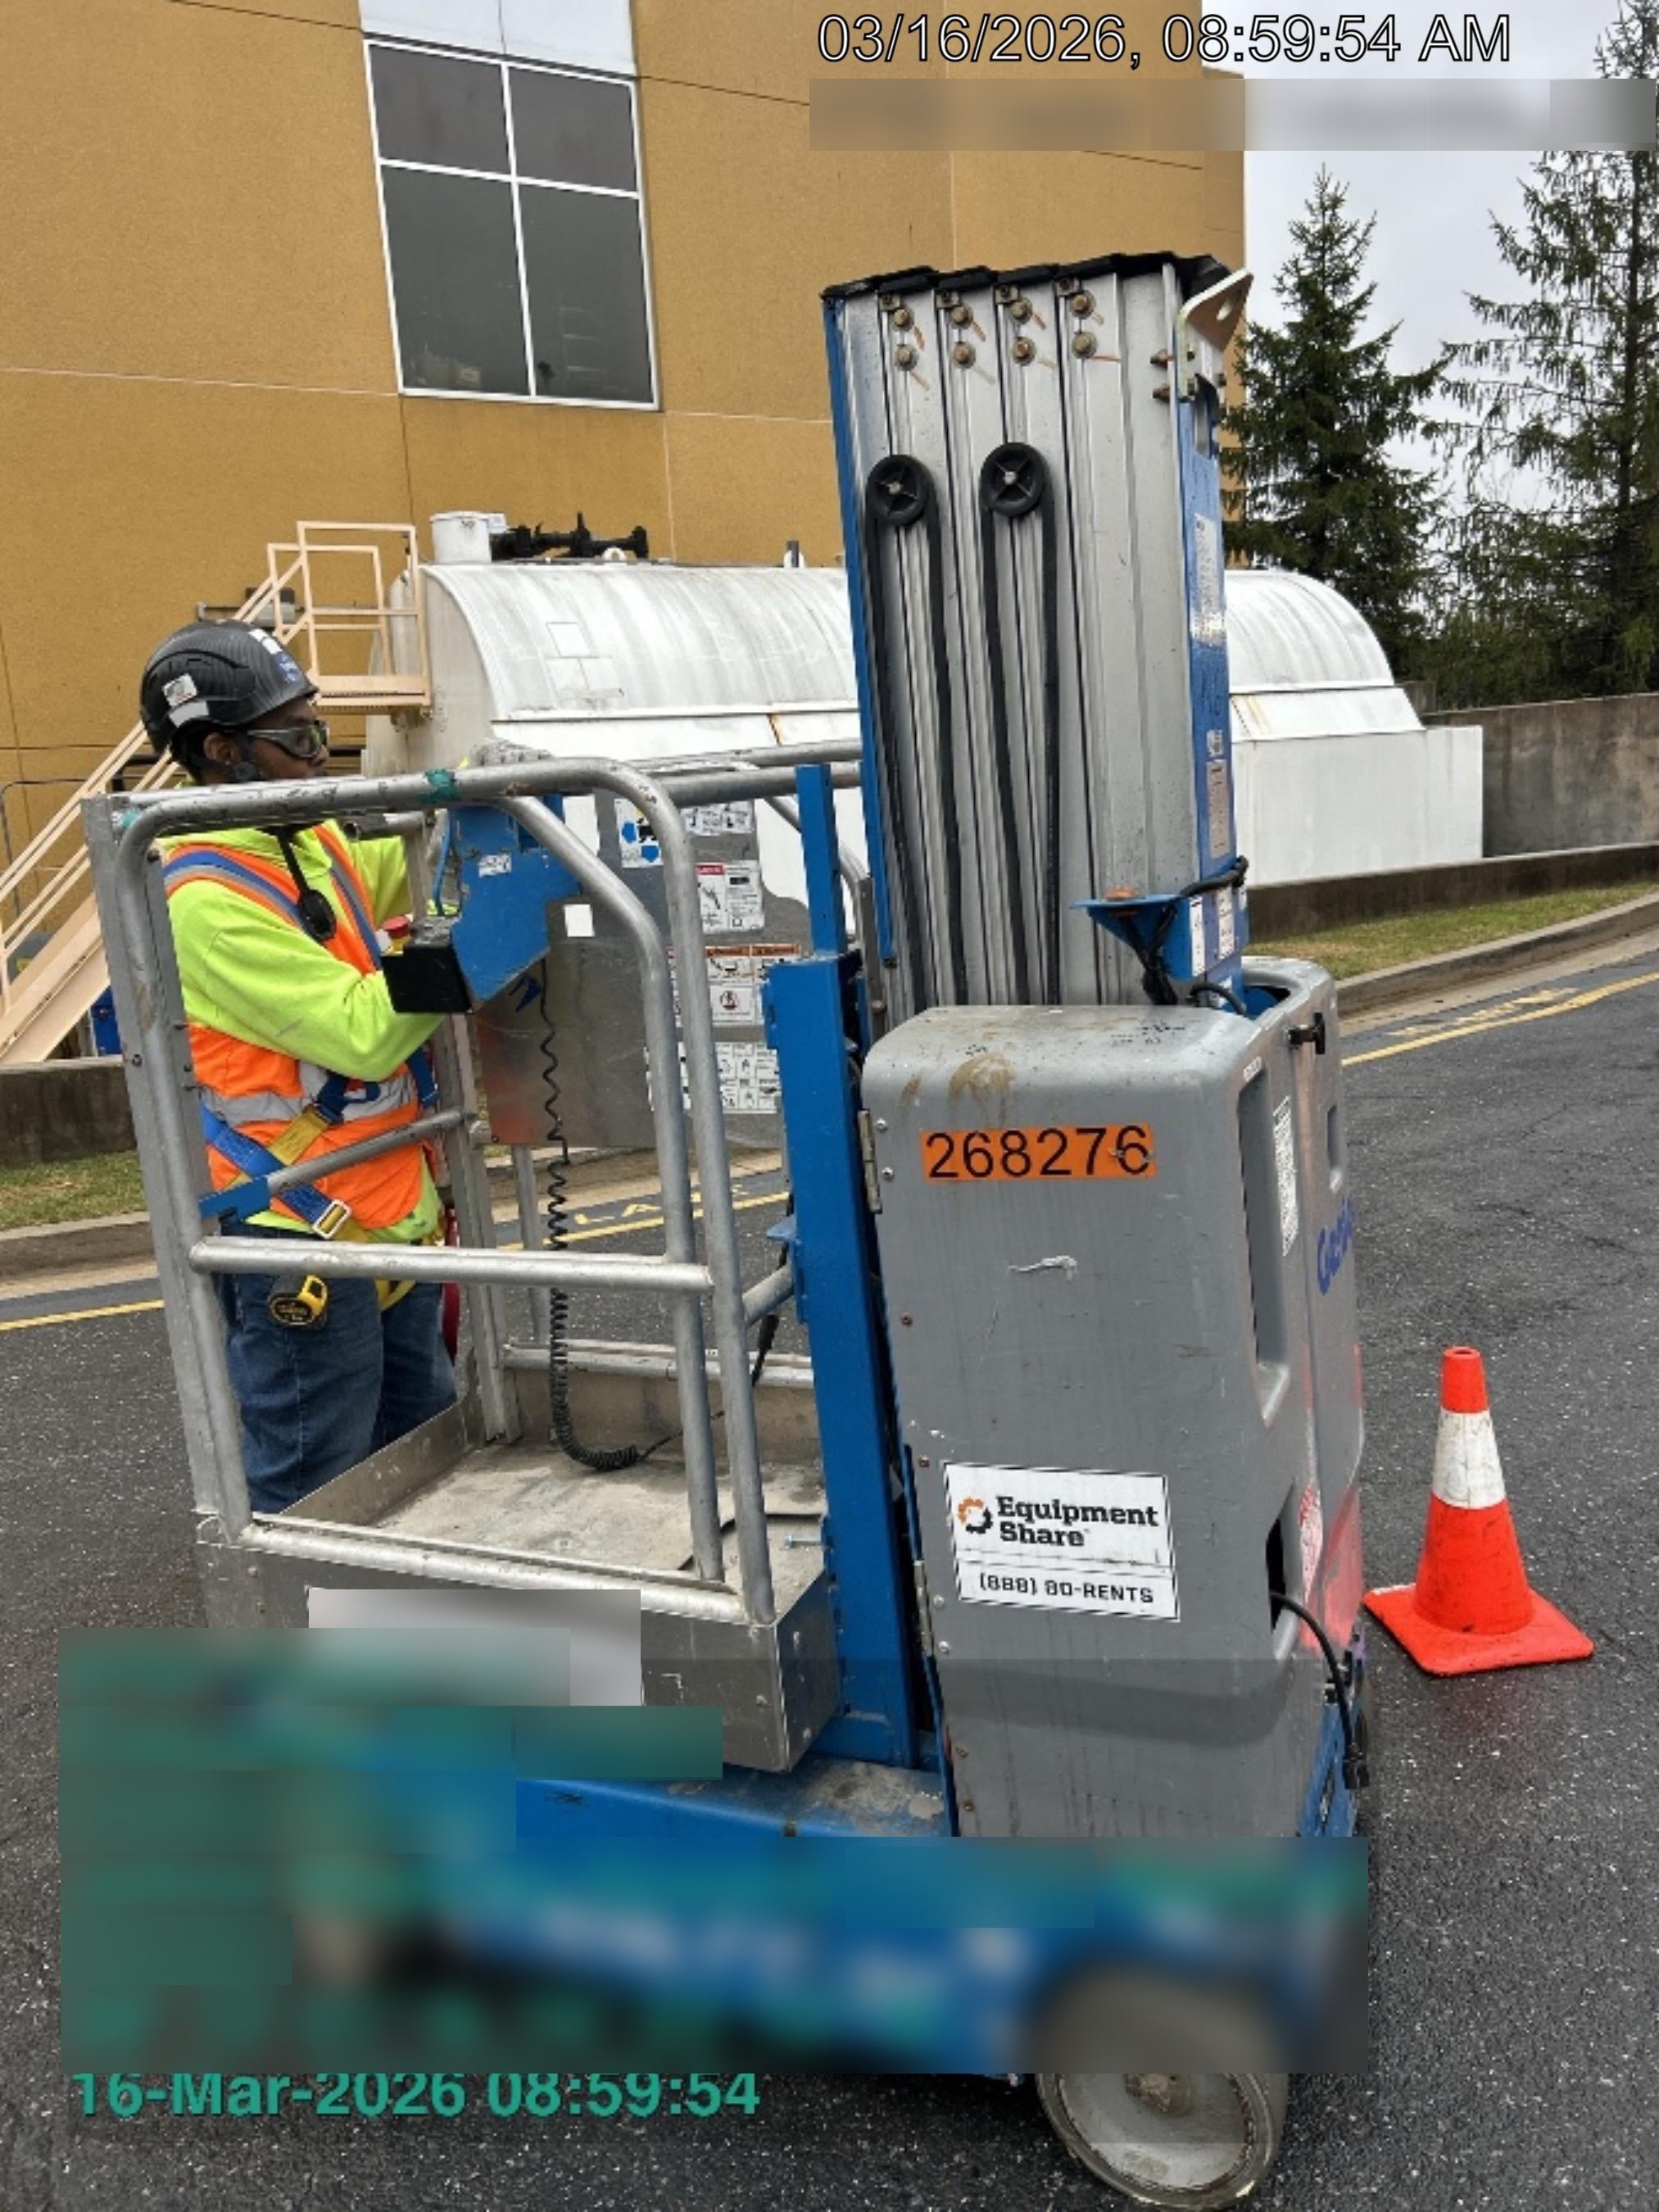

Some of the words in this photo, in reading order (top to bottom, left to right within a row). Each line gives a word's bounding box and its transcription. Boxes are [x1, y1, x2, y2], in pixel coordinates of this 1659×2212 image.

[926, 1125, 1149, 1179] 268276
[995, 1495, 1159, 1527] Equipment
[999, 1521, 1085, 1547] Share
[979, 1572, 1037, 1595] (888)
